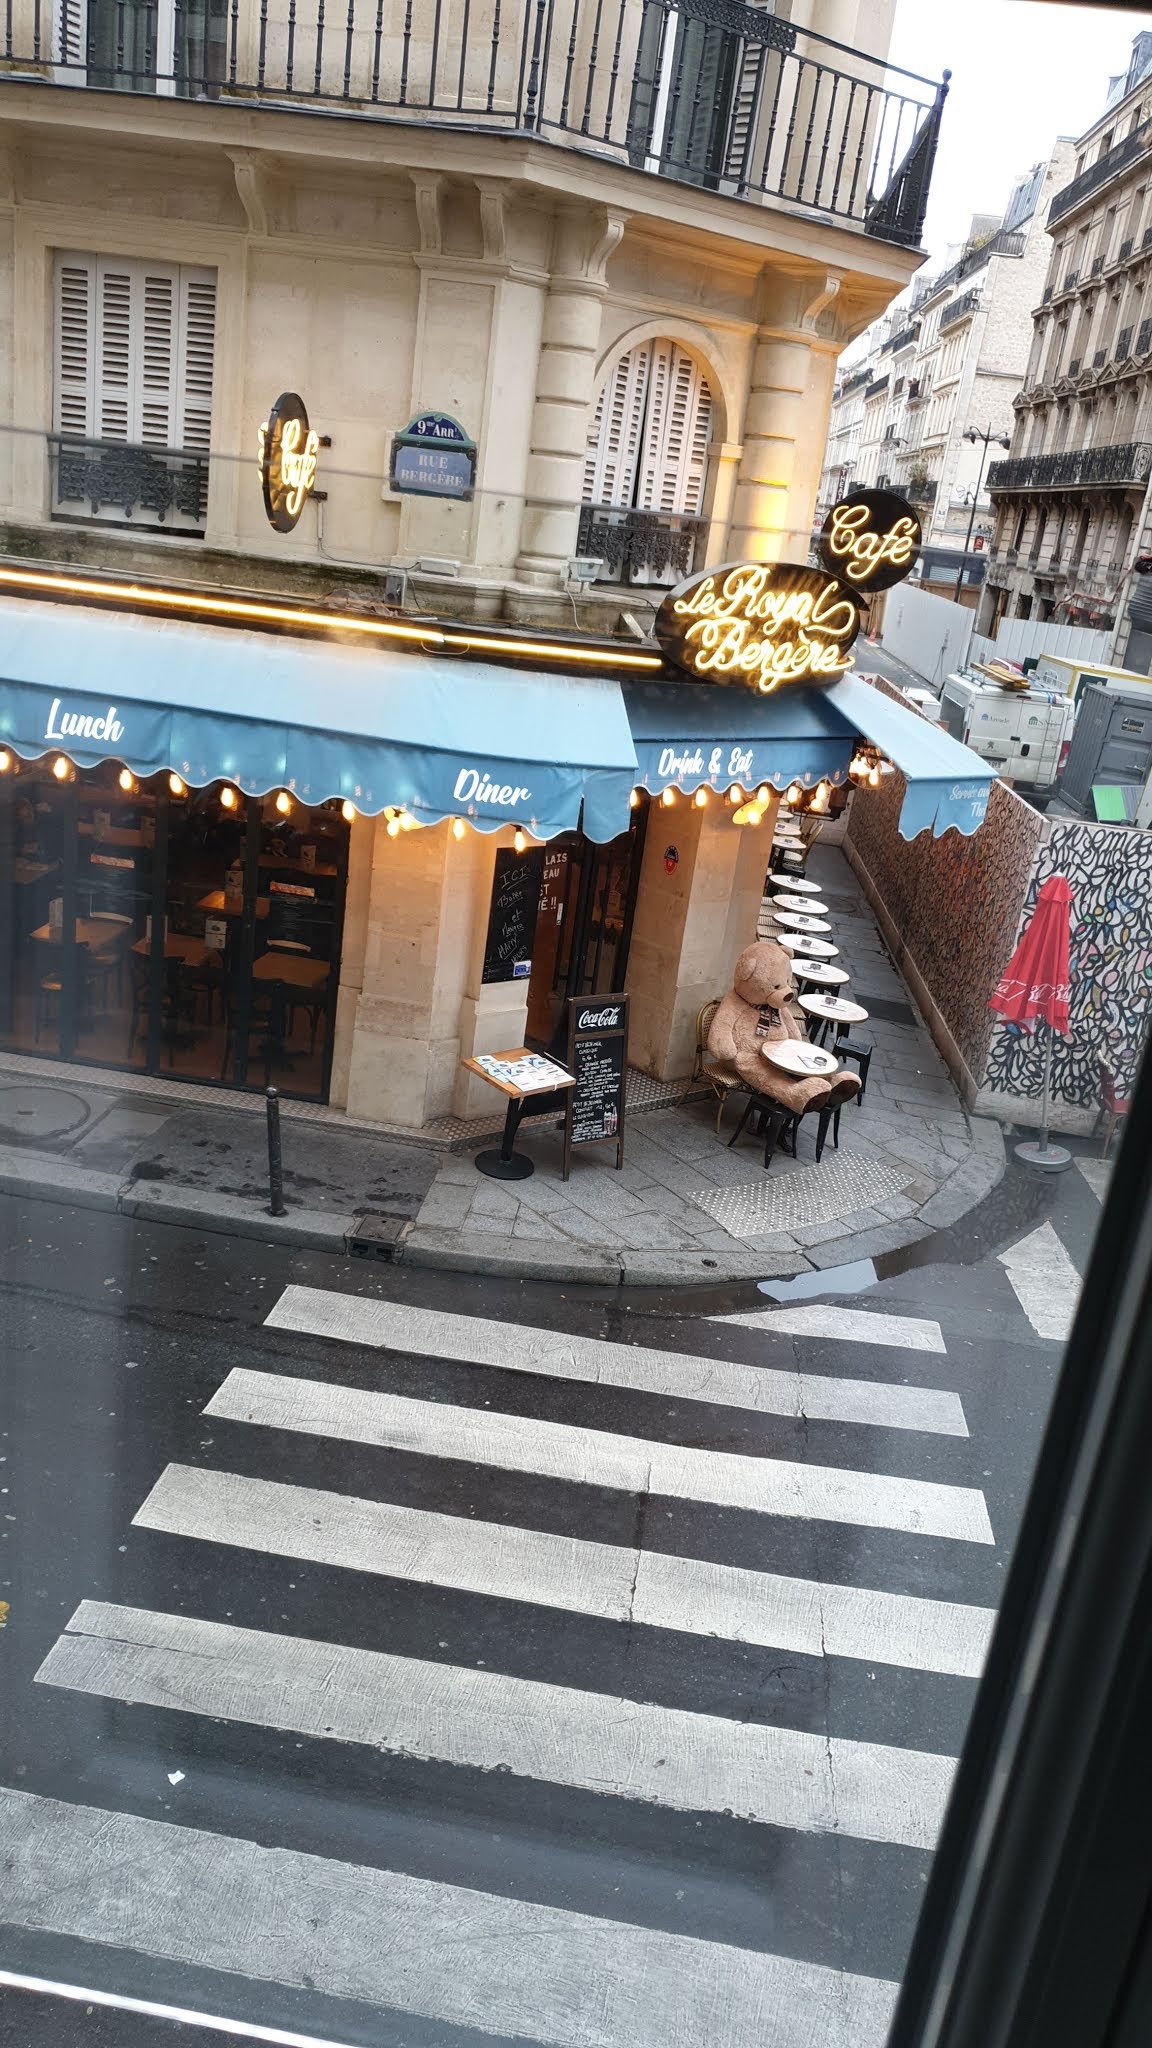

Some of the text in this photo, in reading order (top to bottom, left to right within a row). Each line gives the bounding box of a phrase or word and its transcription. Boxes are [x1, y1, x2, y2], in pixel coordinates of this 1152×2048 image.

[401, 469, 464, 487] BERGÈRE
[418, 454, 448, 469] RUE
[830, 504, 918, 579] Café
[674, 564, 856, 636] Le Royal
[685, 616, 856, 692] Bergère
[44, 697, 125, 742] Lunch
[658, 747, 753, 776] Drink & Eat
[453, 768, 532, 806] Diner
[500, 865, 527, 889] ICI
[578, 1007, 621, 1028] Coca-Cola
